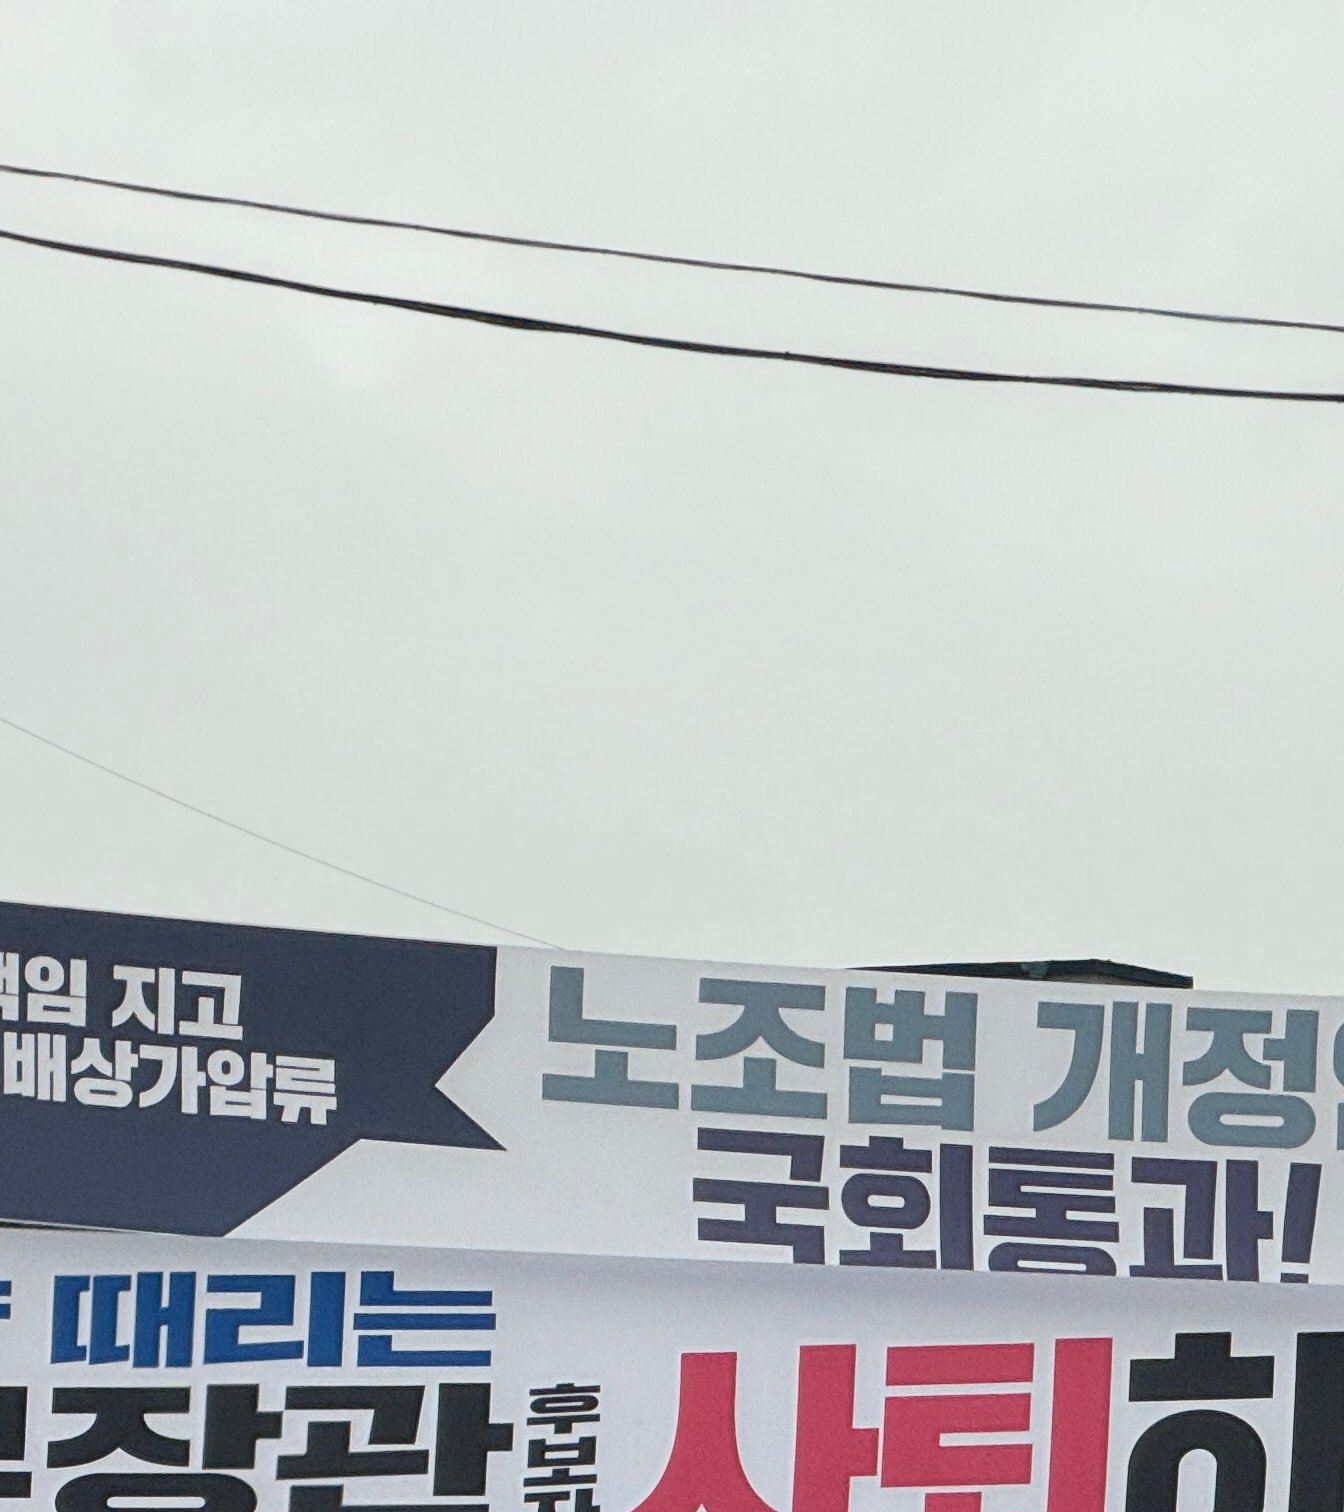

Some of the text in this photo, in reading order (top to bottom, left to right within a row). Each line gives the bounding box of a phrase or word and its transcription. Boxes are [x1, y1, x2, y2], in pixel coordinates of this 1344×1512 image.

[110, 962, 244, 1041] 지고
[541, 964, 979, 1132] 노조법
[690, 1126, 1323, 1284] 국회통과!
[50, 1270, 497, 1369] 때리는
